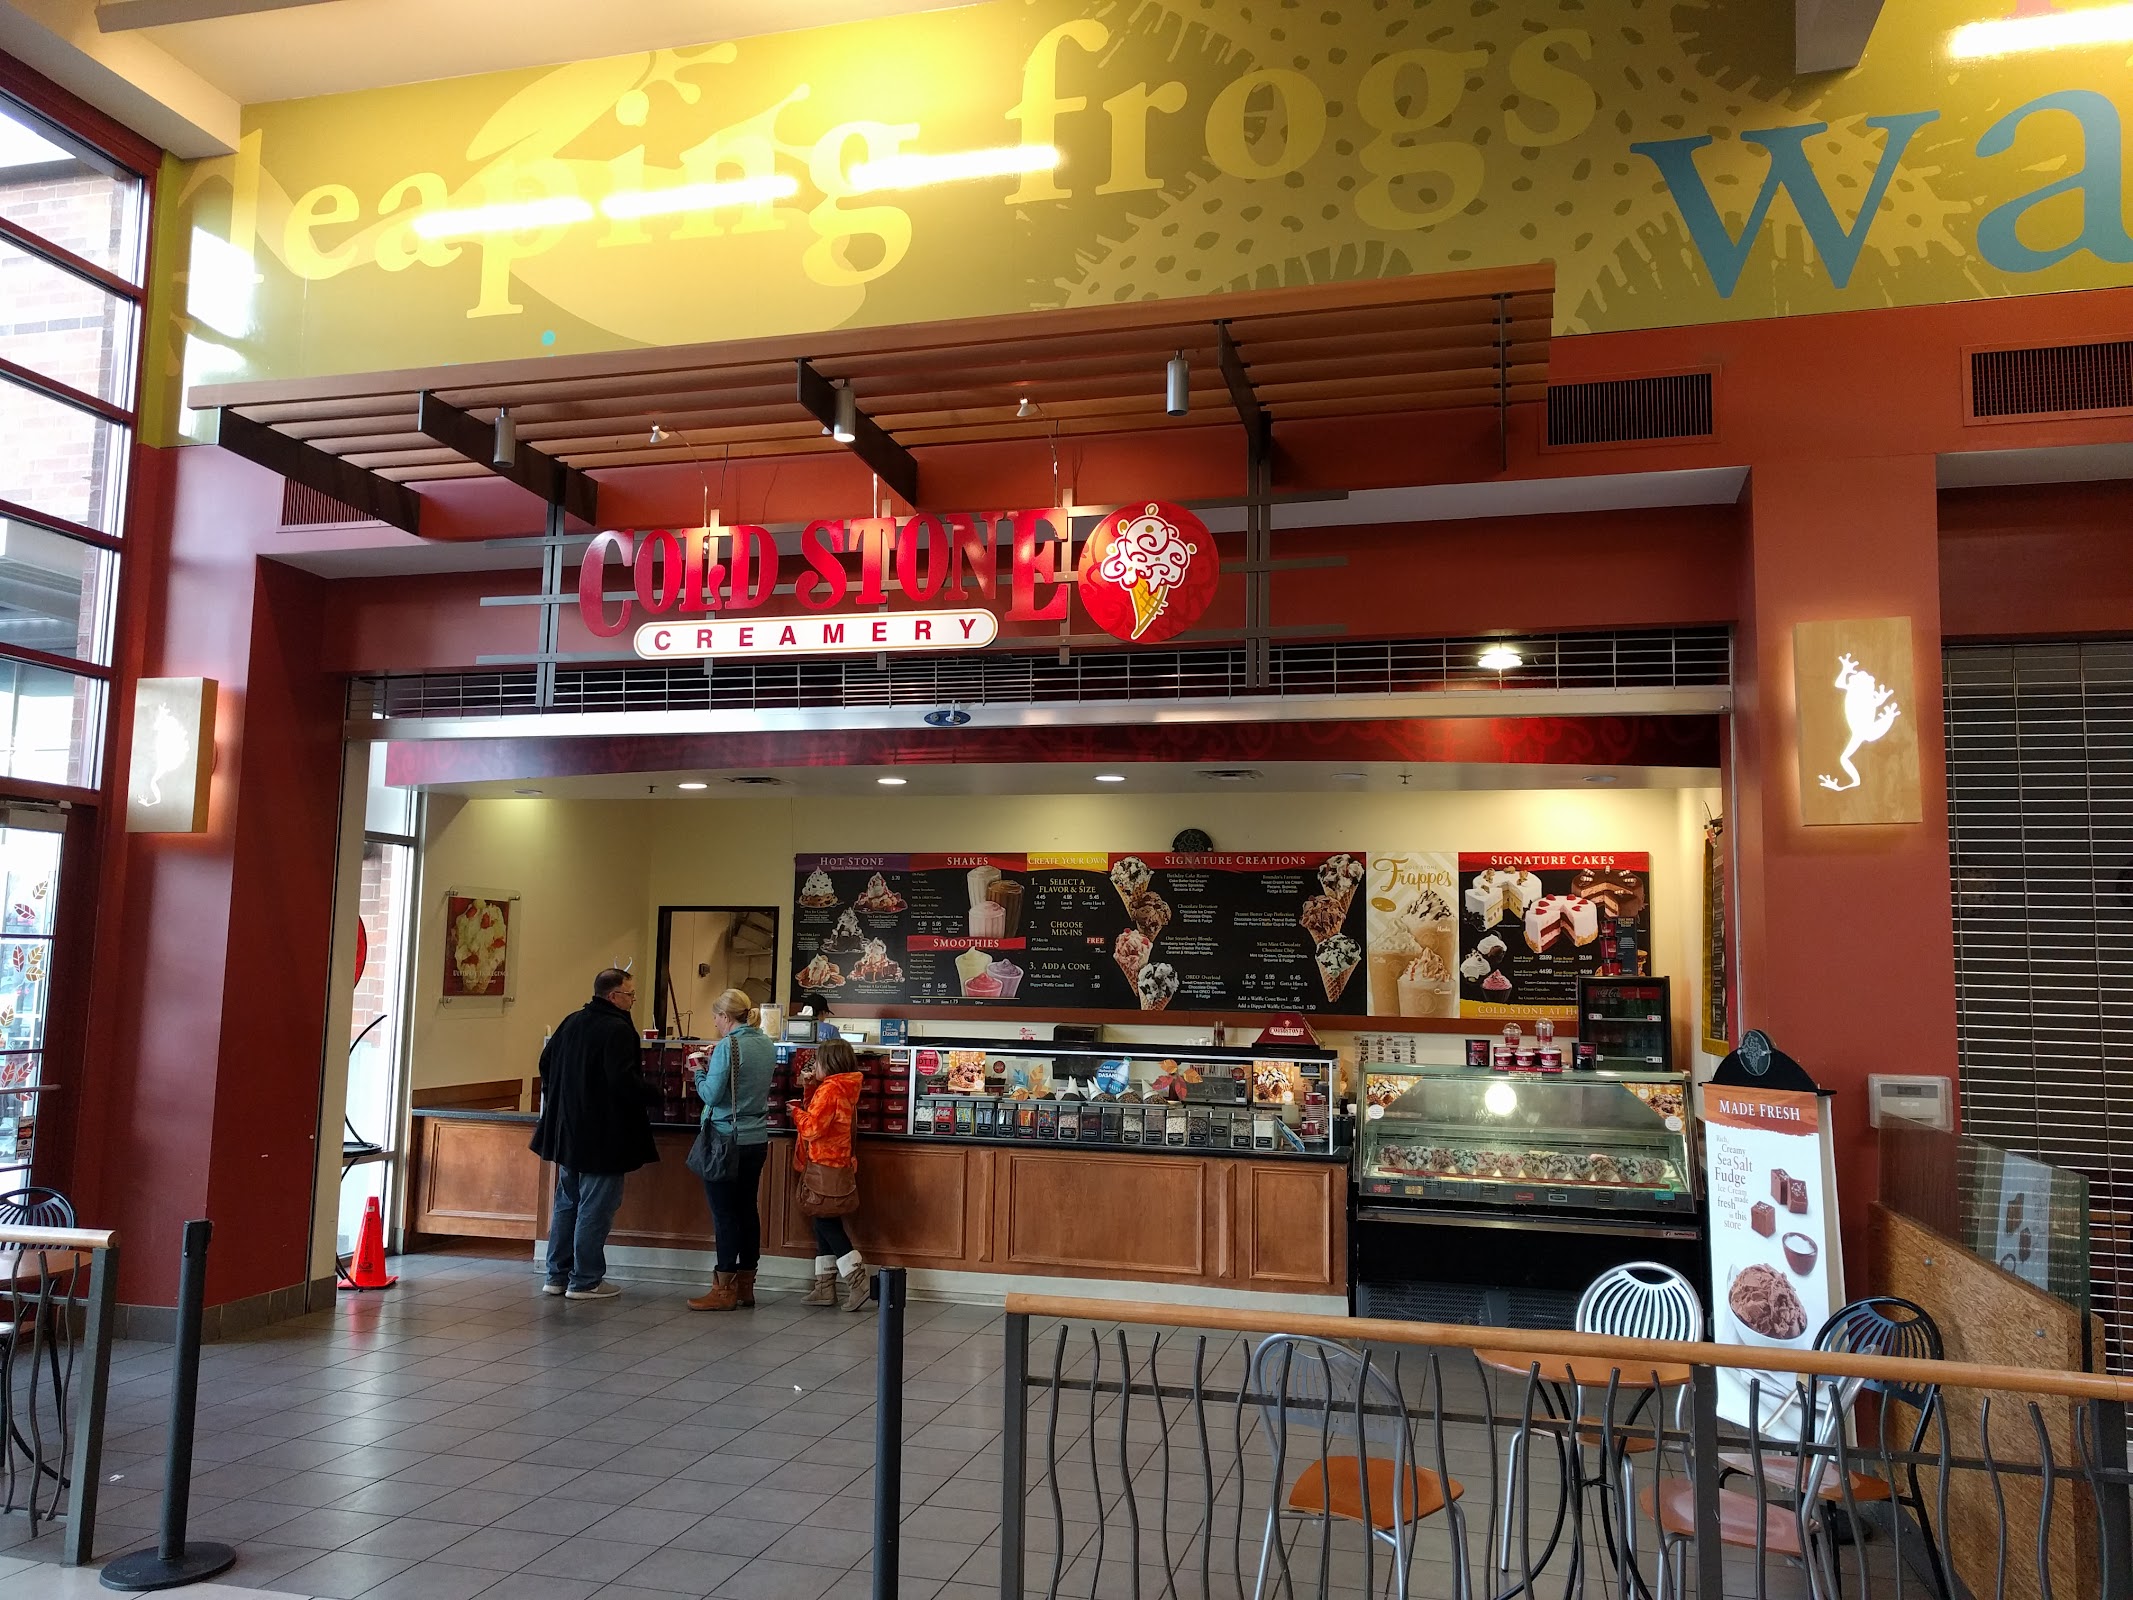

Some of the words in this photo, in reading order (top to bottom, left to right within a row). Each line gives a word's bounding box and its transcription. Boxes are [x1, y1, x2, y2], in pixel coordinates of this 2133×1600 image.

[173, 88, 920, 321] leaping
[1003, 17, 1597, 231] frogs
[578, 525, 779, 638] COLD
[795, 508, 1070, 622] STONE
[653, 618, 978, 651] CREAMERY
[820, 857, 845, 866] HOT
[848, 856, 885, 867] STONE
[947, 857, 989, 866] SHAKES
[1028, 857, 1059, 866] CREATE
[1061, 857, 1086, 866] YOUR
[1086, 858, 1107, 866] OWN
[1164, 855, 1232, 865] SIGNATURE
[1236, 855, 1306, 866] CREATIONS
[1491, 855, 1568, 866] SIGNATURE
[1571, 855, 1615, 865] CAKES
[1372, 857, 1452, 892] Frappés
[1031, 877, 1038, 885] 1.
[1049, 877, 1078, 886] SELECT
[1079, 878, 1085, 886] A
[1039, 886, 1069, 894] FLAVOR
[1070, 886, 1077, 894] &
[1078, 886, 1096, 894] SIZE
[1029, 920, 1037, 929] 2.
[1050, 920, 1084, 929] CHOOSE
[1051, 928, 1083, 937] MIX-INS
[933, 938, 999, 948] SMOOTHIES
[1029, 961, 1036, 970] 3.
[1041, 962, 1059, 970] ADD
[1060, 962, 1066, 970] A
[1067, 962, 1091, 971] CONE
[1477, 1005, 1507, 1015] COLD
[1509, 1006, 1546, 1015] STONE
[1549, 1007, 1562, 1015] AT
[1718, 1099, 1756, 1117] MADE
[1759, 1103, 1801, 1122] FRESH
[1715, 1134, 1730, 1143] Rich,
[1721, 1143, 1746, 1159] Creamy
[1717, 1152, 1733, 1167] Sea
[1733, 1155, 1753, 1172] Salt
[1714, 1166, 1747, 1188] Fudge
[1717, 1183, 1726, 1193] Ice
[1727, 1185, 1748, 1197] Cream
[1717, 1196, 1736, 1210] fresh
[1734, 1195, 1749, 1204] made
[1735, 1211, 1748, 1222] this
[1723, 1219, 1742, 1231] store
